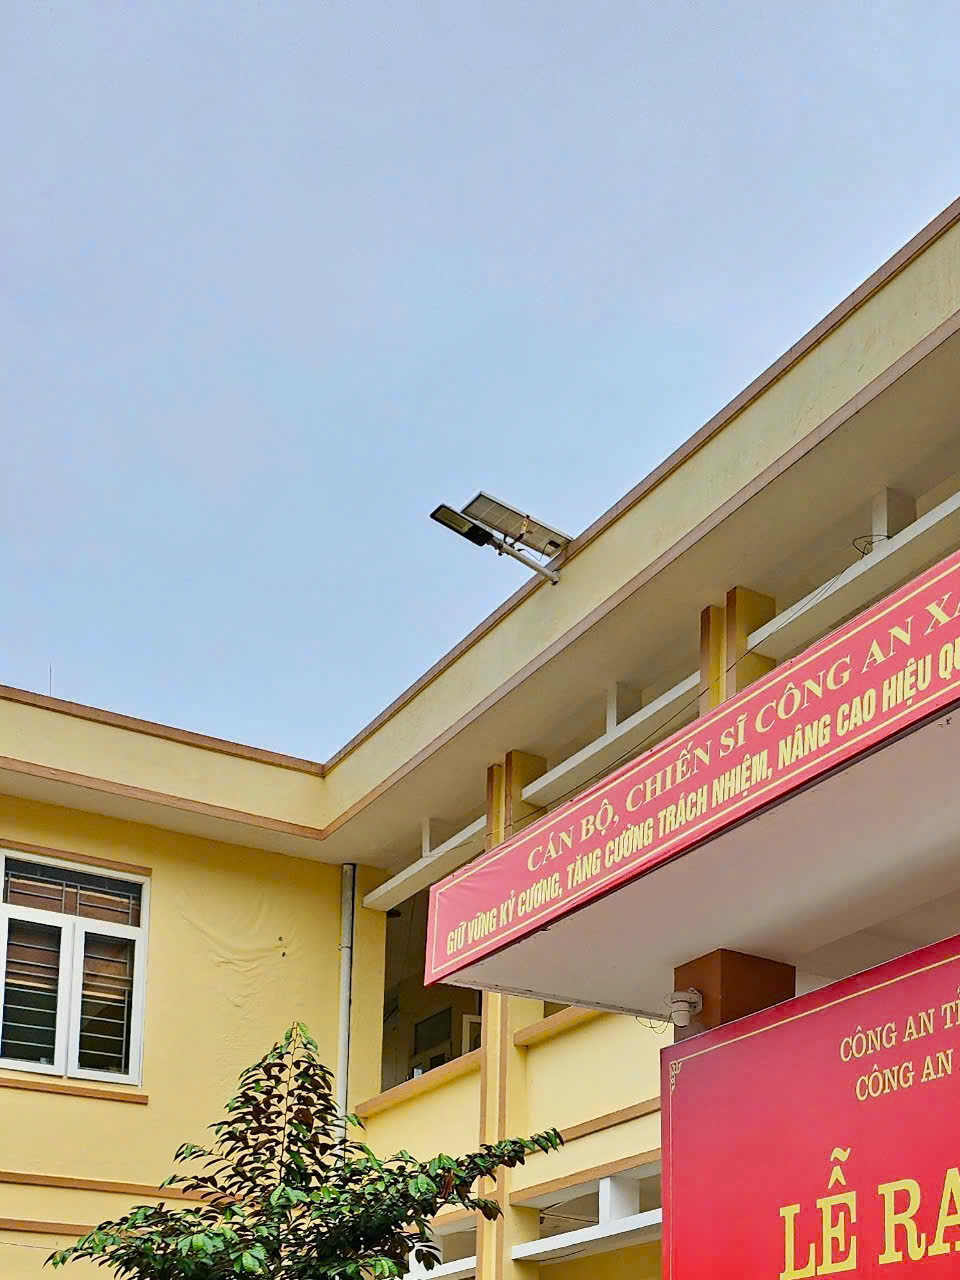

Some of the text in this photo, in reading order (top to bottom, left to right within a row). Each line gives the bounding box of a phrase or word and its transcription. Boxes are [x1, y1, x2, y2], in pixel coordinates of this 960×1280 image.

[527, 827, 573, 872] CÁN
[581, 801, 619, 838] BỘ,
[626, 741, 712, 812] CHIẾN
[719, 717, 747, 758] SĨ
[754, 656, 852, 732] CÔNG
[860, 617, 913, 674] AN
[658, 784, 708, 838] TRÁCH
[711, 754, 772, 808] NHIỆM,
[777, 715, 831, 767] NÂNG
[837, 689, 875, 737] CAO
[882, 656, 932, 712] HIỆU
[839, 1019, 896, 1062] CÔNG
[903, 1009, 935, 1042] AN
[855, 1062, 915, 1101] CÔNG
[921, 1050, 954, 1083] AN
